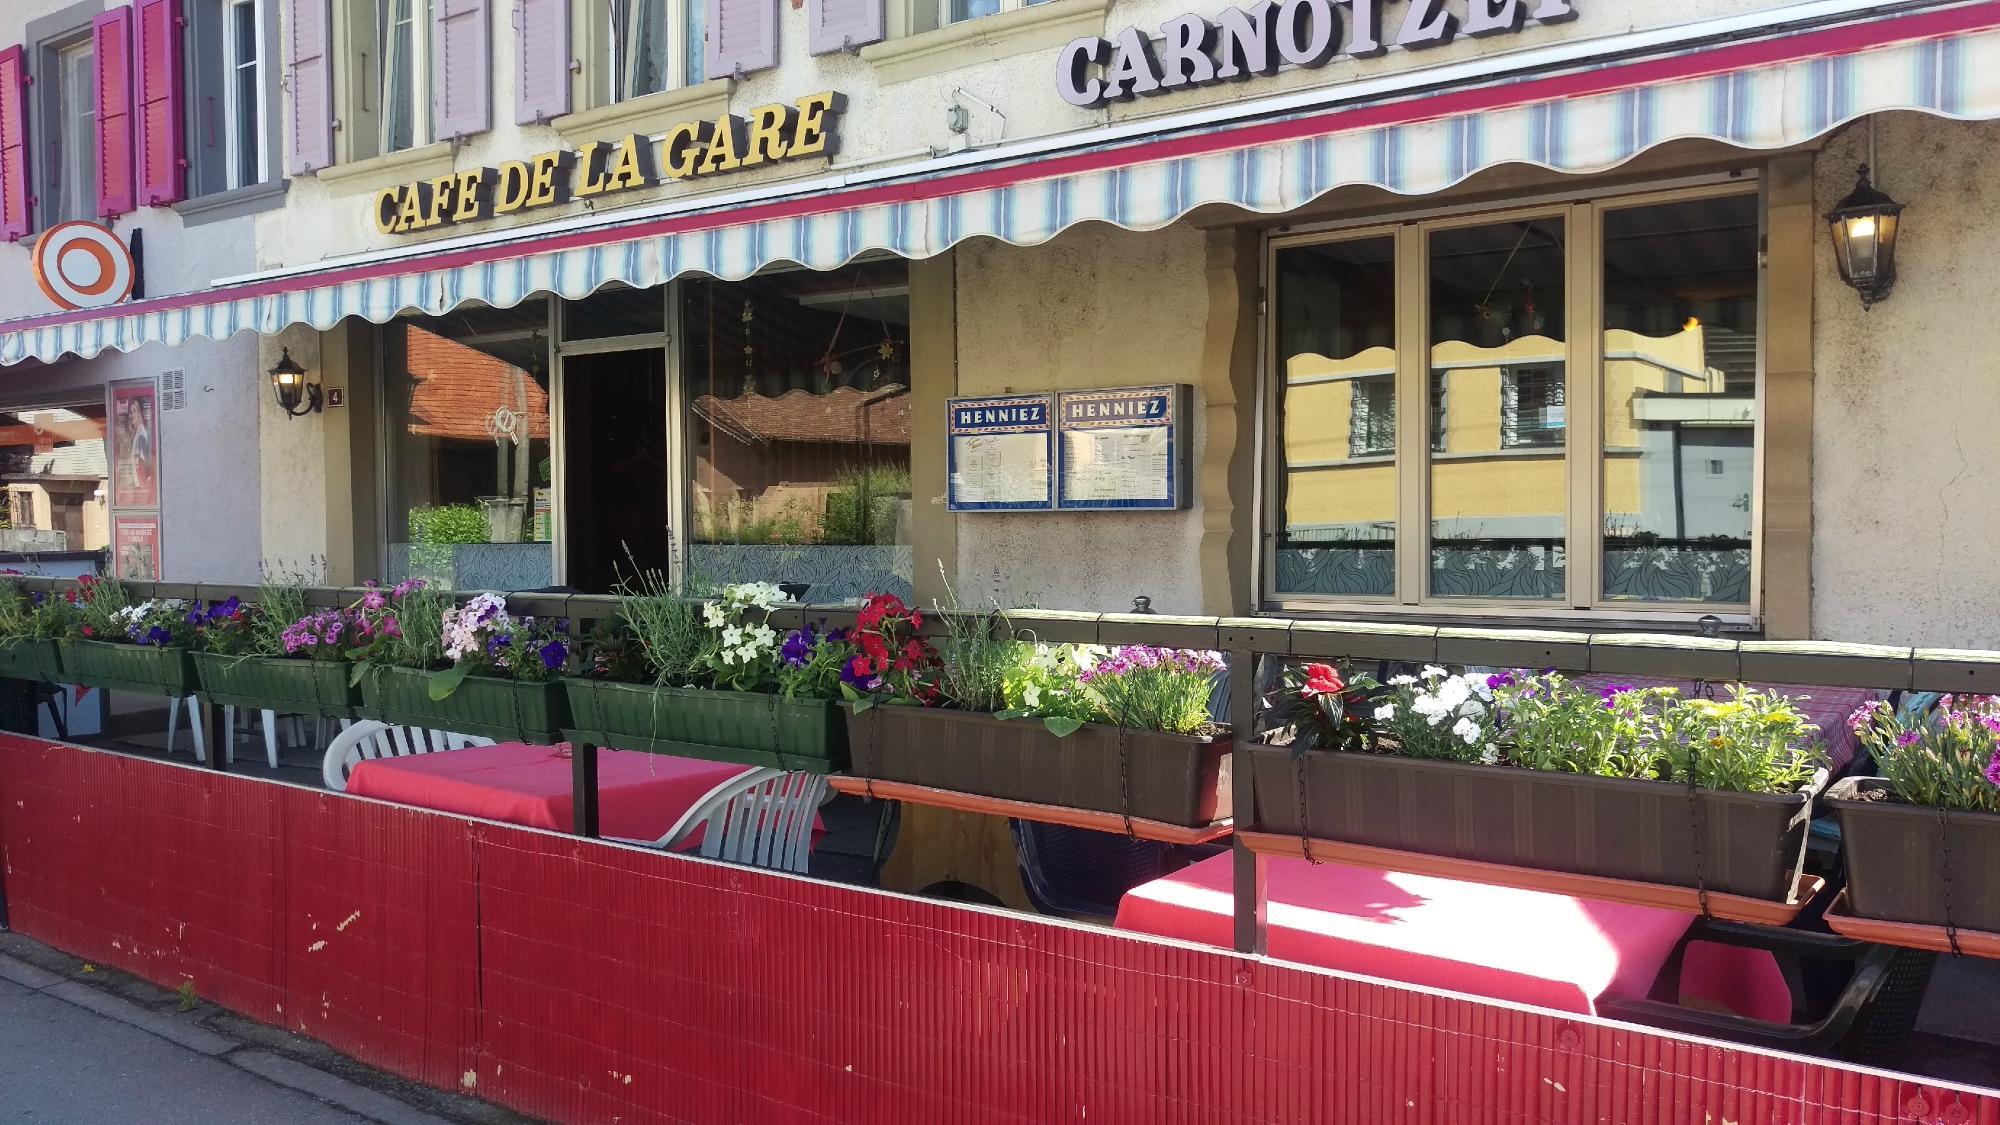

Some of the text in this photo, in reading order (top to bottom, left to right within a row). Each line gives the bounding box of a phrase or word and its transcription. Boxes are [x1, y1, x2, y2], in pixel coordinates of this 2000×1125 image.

[1056, 0, 1573, 106] CARNOTZE
[374, 90, 836, 235] CAFE DE LA GARE
[332, 391, 339, 403] 4
[960, 407, 1040, 425] HENNIEZ
[1072, 399, 1161, 418] HENNIEZ
